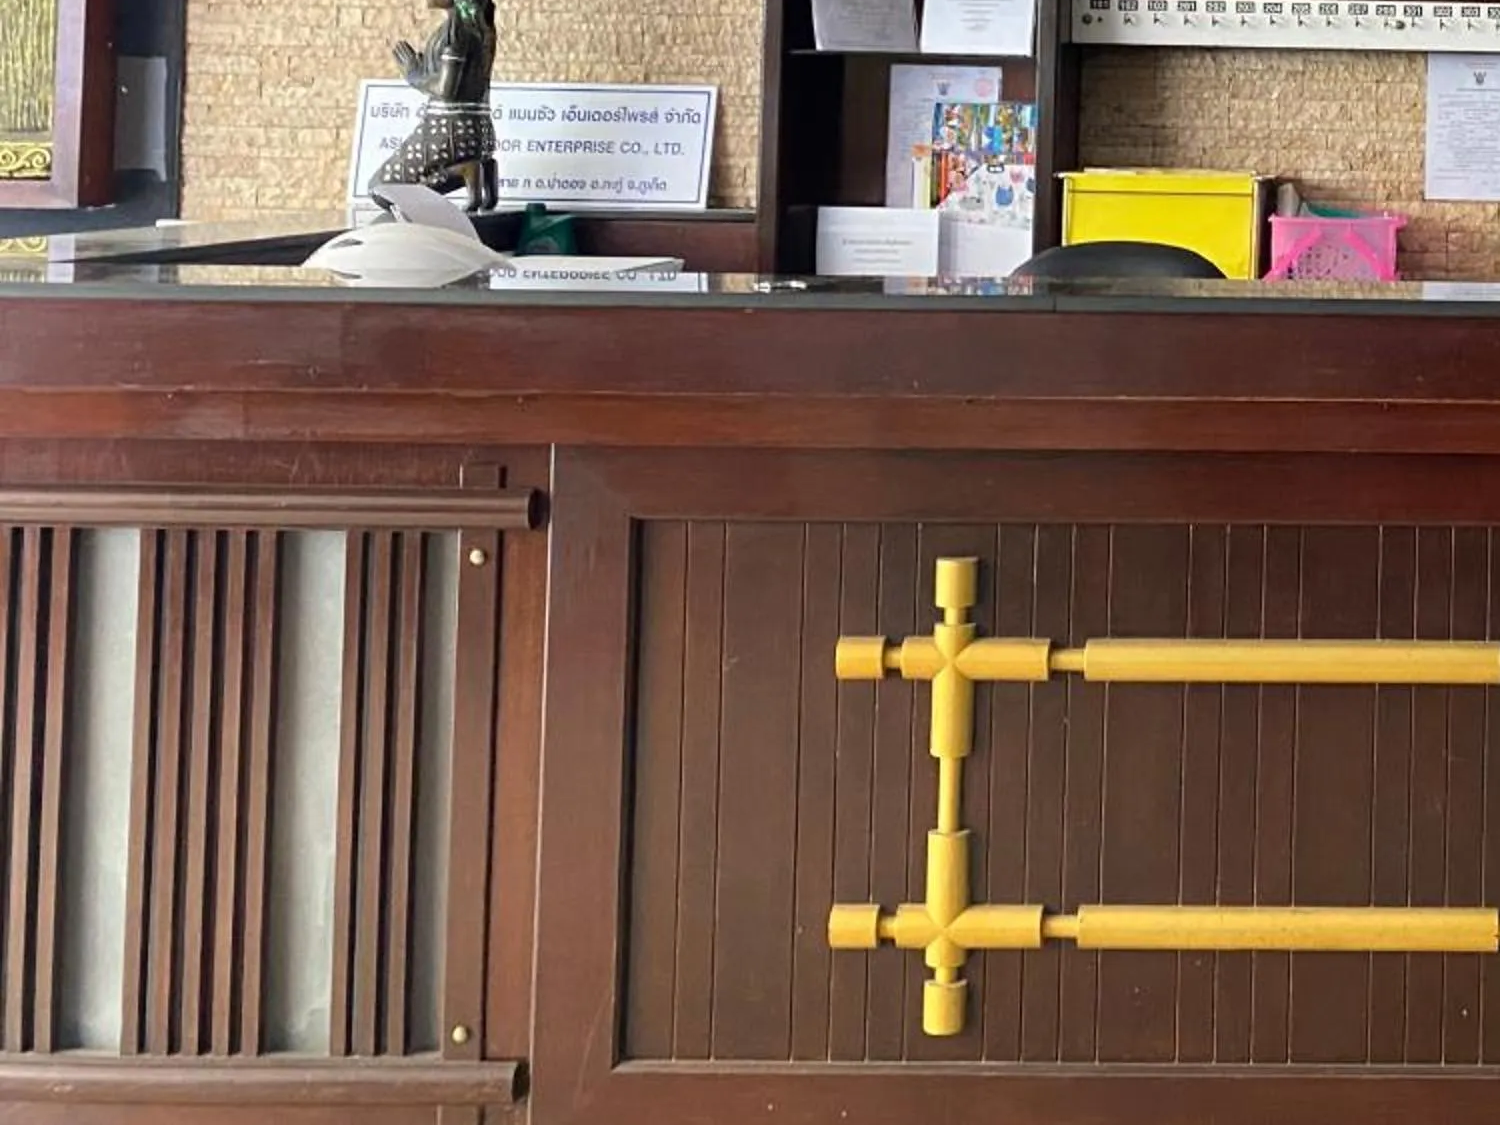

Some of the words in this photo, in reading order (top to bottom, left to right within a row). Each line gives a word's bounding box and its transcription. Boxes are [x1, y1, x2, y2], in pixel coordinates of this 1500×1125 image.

[1264, 3, 1283, 13] 204
[1404, 6, 1422, 17] 301
[371, 102, 409, 118] บริษัท
[665, 108, 702, 124] จำกัด
[527, 140, 614, 154] ENTERPRISE
